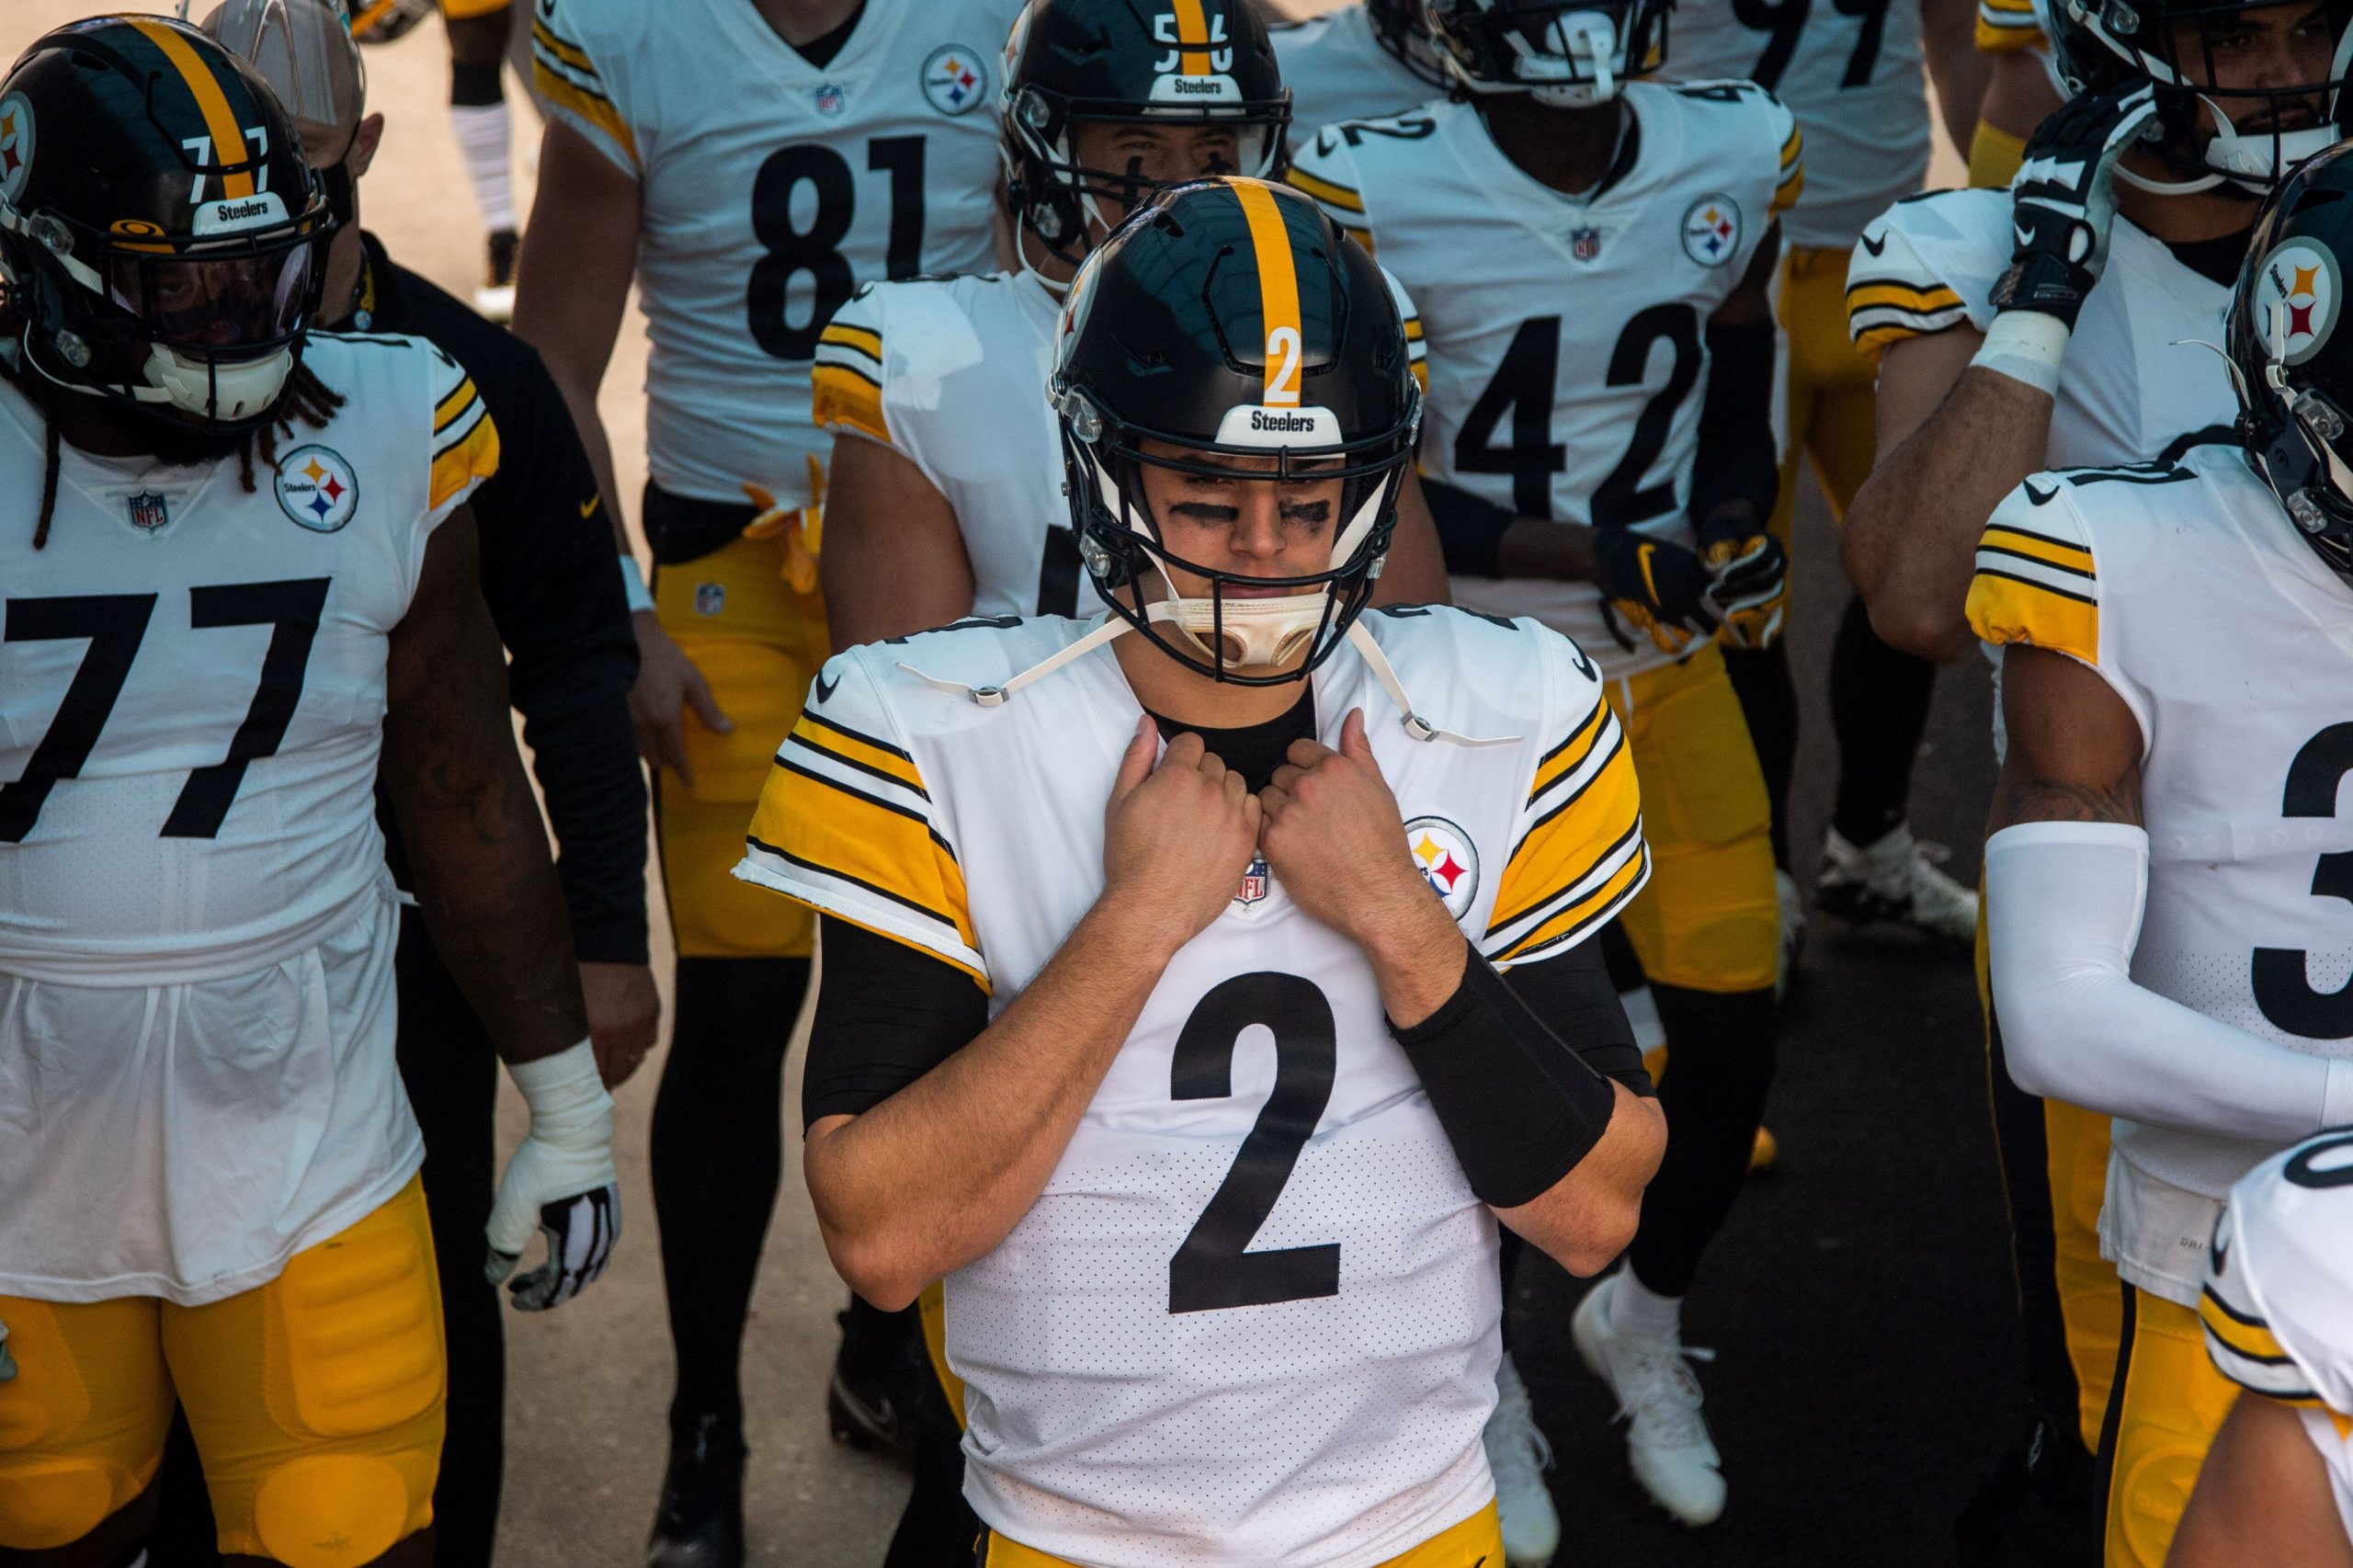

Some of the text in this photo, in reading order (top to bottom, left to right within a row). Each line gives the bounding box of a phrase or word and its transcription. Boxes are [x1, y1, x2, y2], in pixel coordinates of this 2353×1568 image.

[1154, 14, 1233, 72] 56
[1175, 78, 1222, 94] Steelers
[182, 126, 268, 204] 77
[218, 200, 268, 222] Steelers
[747, 135, 927, 360] 81
[2269, 263, 2288, 300] Steelers
[1264, 326, 1301, 403] 2
[1251, 410, 1314, 432] Steelers
[1455, 302, 1702, 527] 42
[283, 482, 316, 493] Steelers
[134, 506, 164, 525] NFL
[0, 576, 332, 843] 77
[1238, 878, 1263, 900] FL
[1169, 971, 1341, 1314] 2
